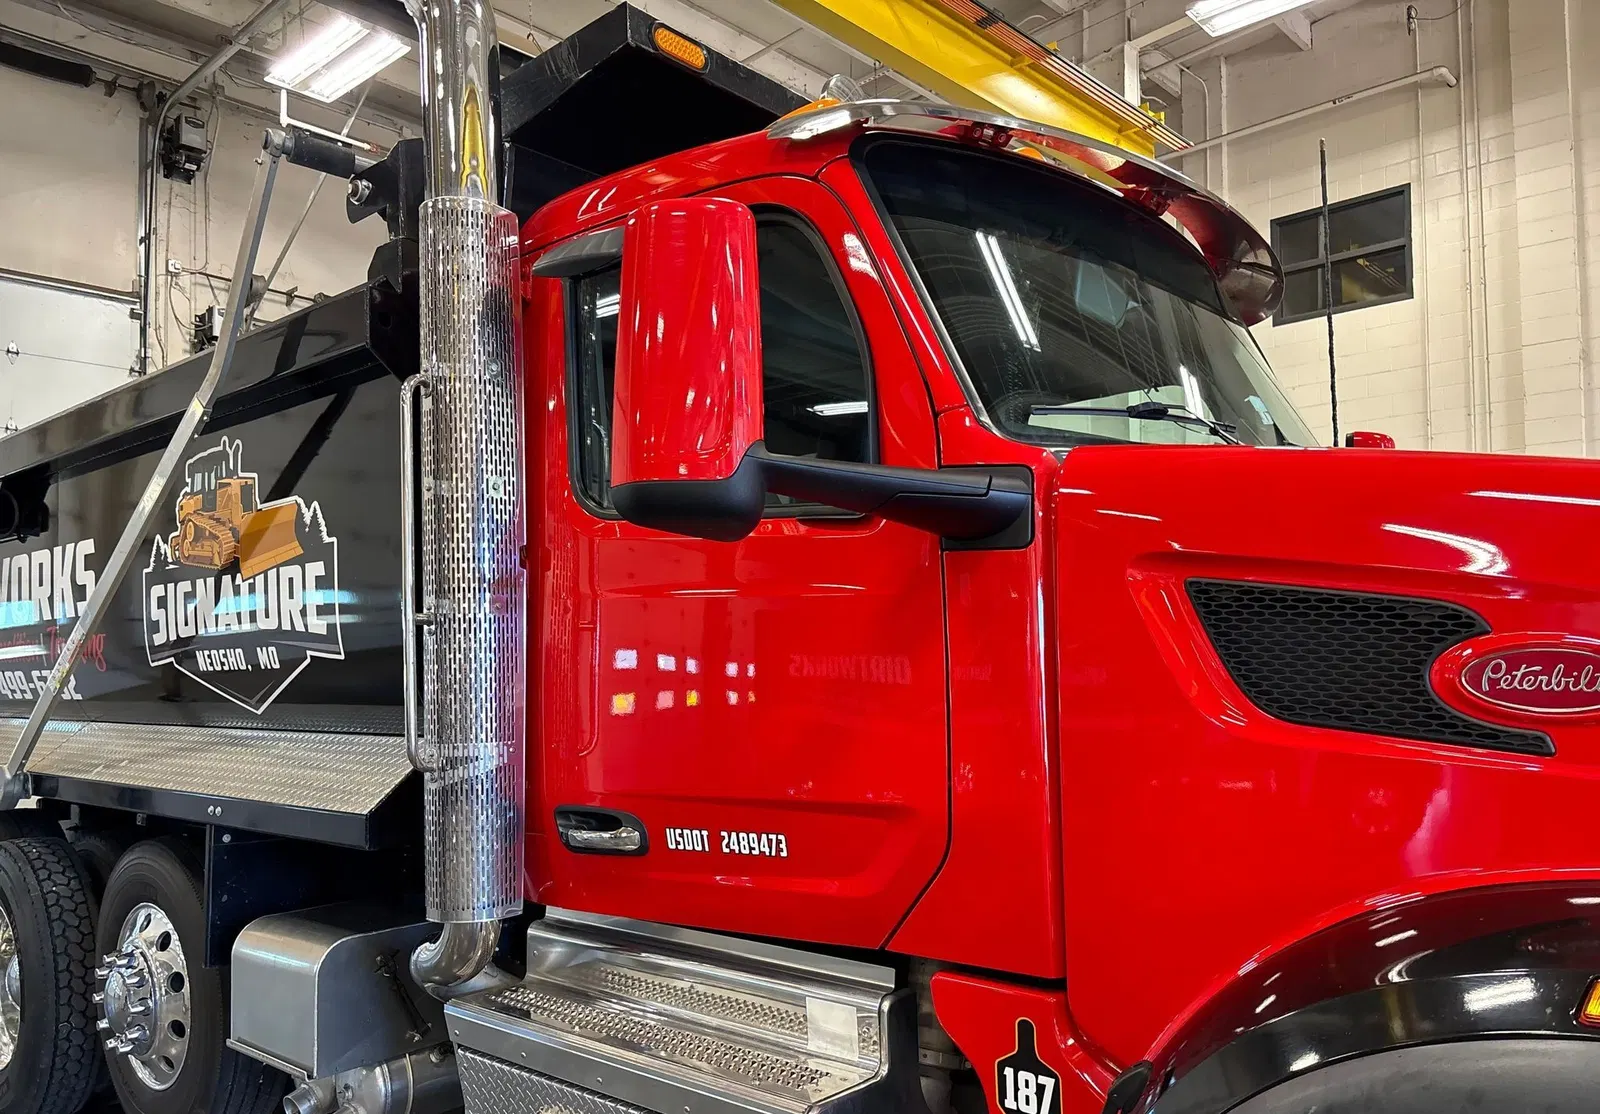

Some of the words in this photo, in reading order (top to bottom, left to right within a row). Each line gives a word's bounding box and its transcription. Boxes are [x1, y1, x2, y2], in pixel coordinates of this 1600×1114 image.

[150, 561, 328, 646] SIGNATURE
[195, 648, 252, 672] NEOSHO,
[256, 646, 280, 670] MO
[0, 670, 83, 700] 499-62
[665, 827, 710, 852] USDOT
[720, 830, 788, 857] 2489473
[1003, 1066, 1056, 1114] 187
